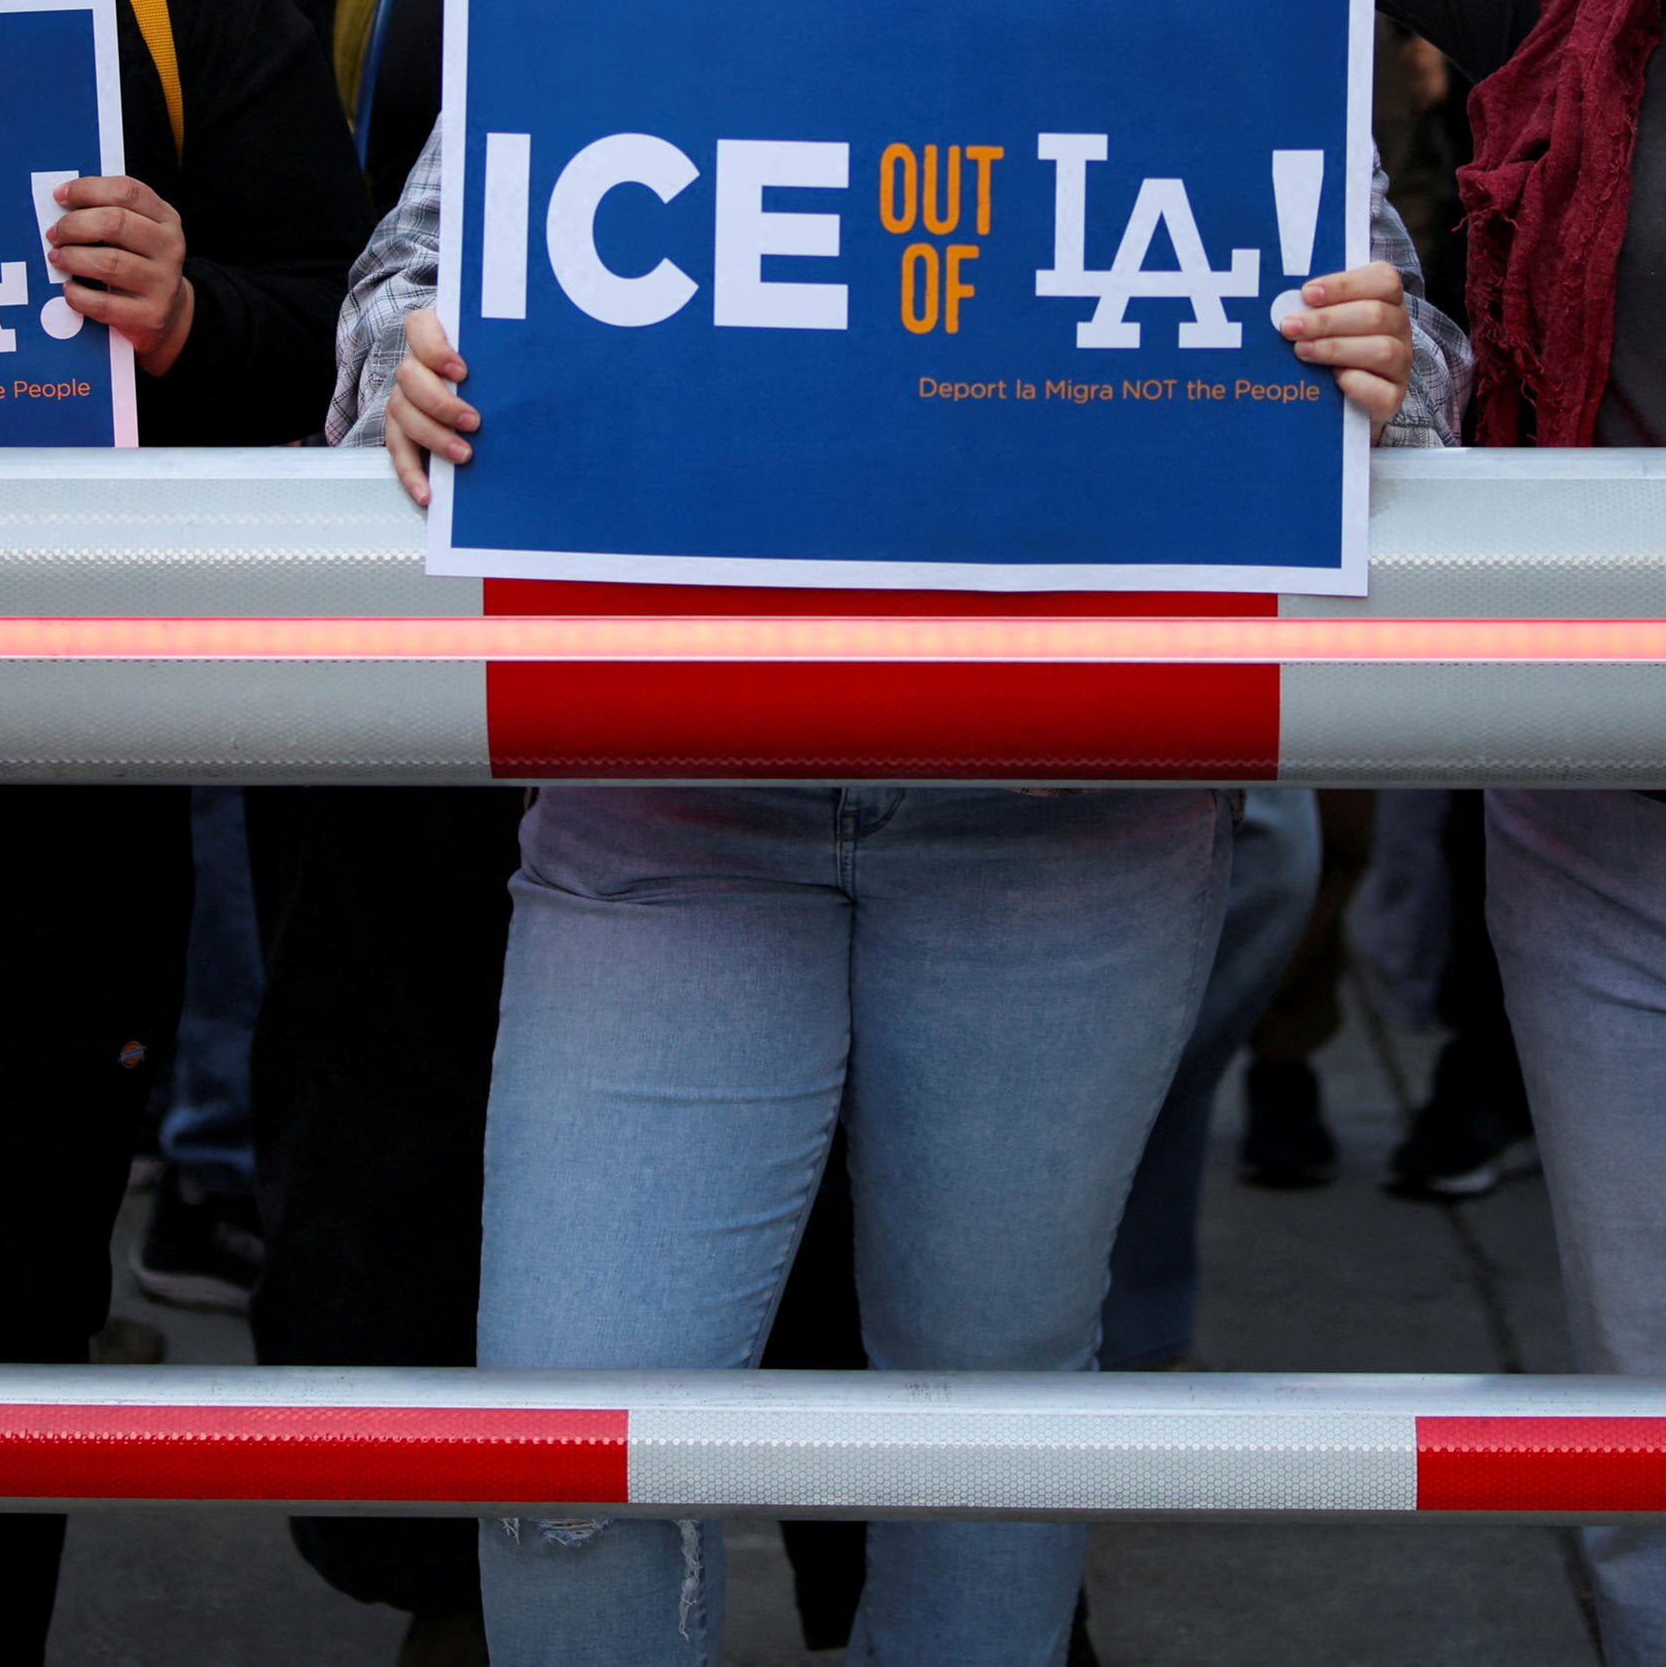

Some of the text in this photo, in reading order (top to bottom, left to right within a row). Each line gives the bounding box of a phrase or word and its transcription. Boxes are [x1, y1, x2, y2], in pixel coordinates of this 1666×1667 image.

[480, 131, 851, 331] ICE
[879, 142, 1006, 236] OUT
[900, 241, 982, 336] OF
[13, 377, 92, 399] People
[918, 376, 1322, 404] Deport la Migra NOT the People
